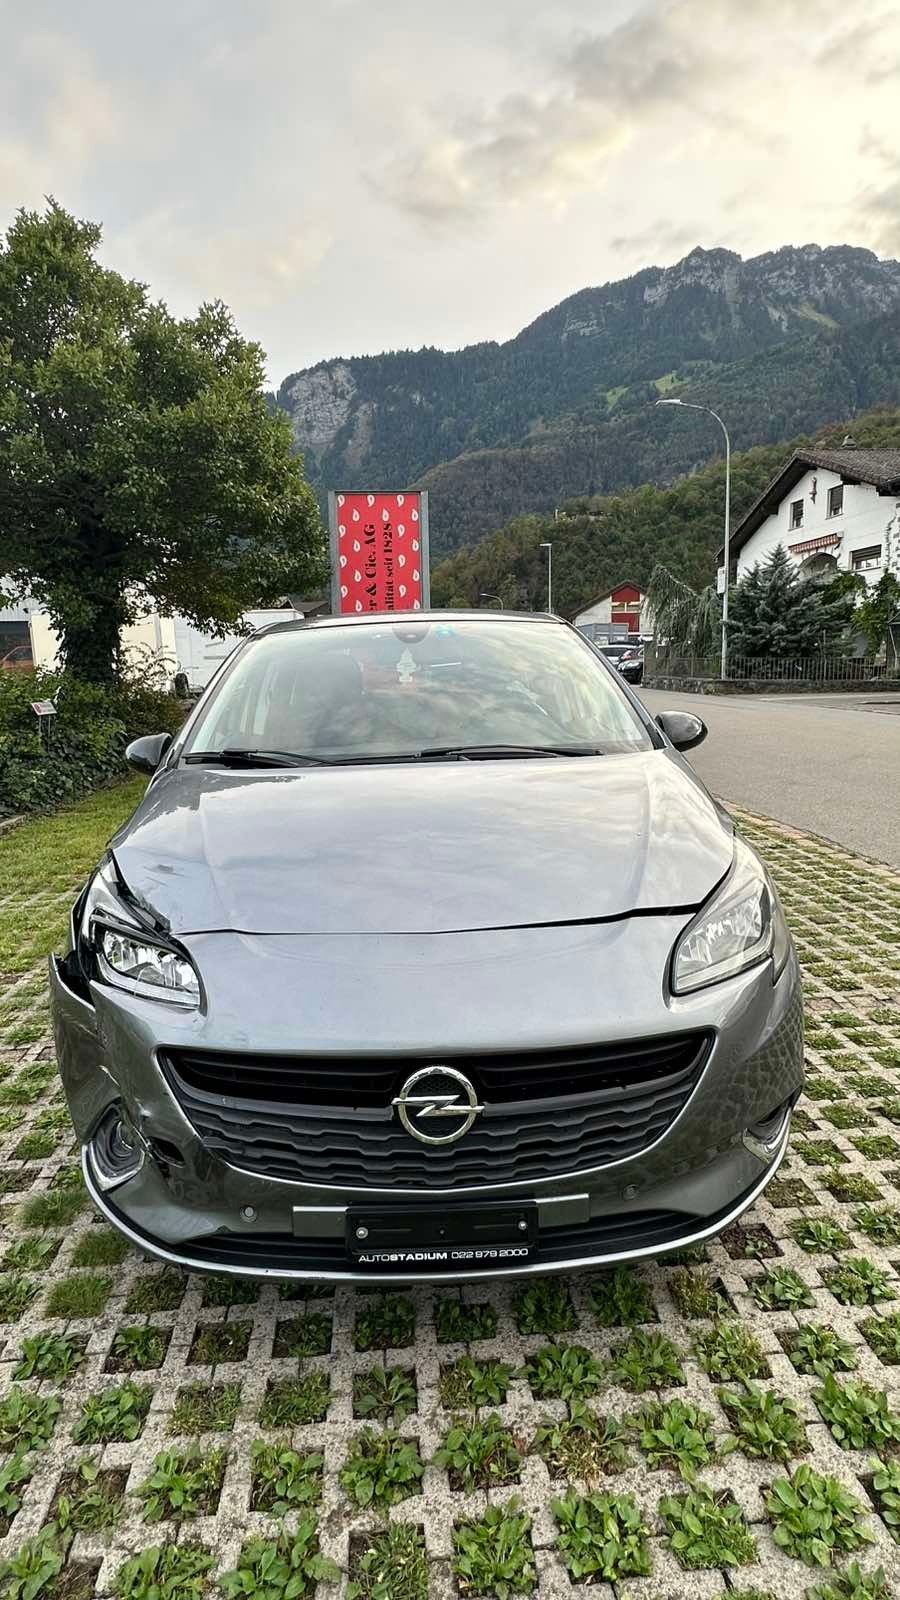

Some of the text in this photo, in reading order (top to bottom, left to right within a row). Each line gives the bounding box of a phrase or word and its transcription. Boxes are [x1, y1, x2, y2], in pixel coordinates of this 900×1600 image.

[363, 523, 376, 549] AG
[383, 523, 393, 553] 1828
[364, 551, 377, 579] Cie.
[383, 557, 393, 577] seit
[365, 581, 377, 597] &
[358, 1248, 528, 1263] AUTOSTADIUM 022 979 2000
